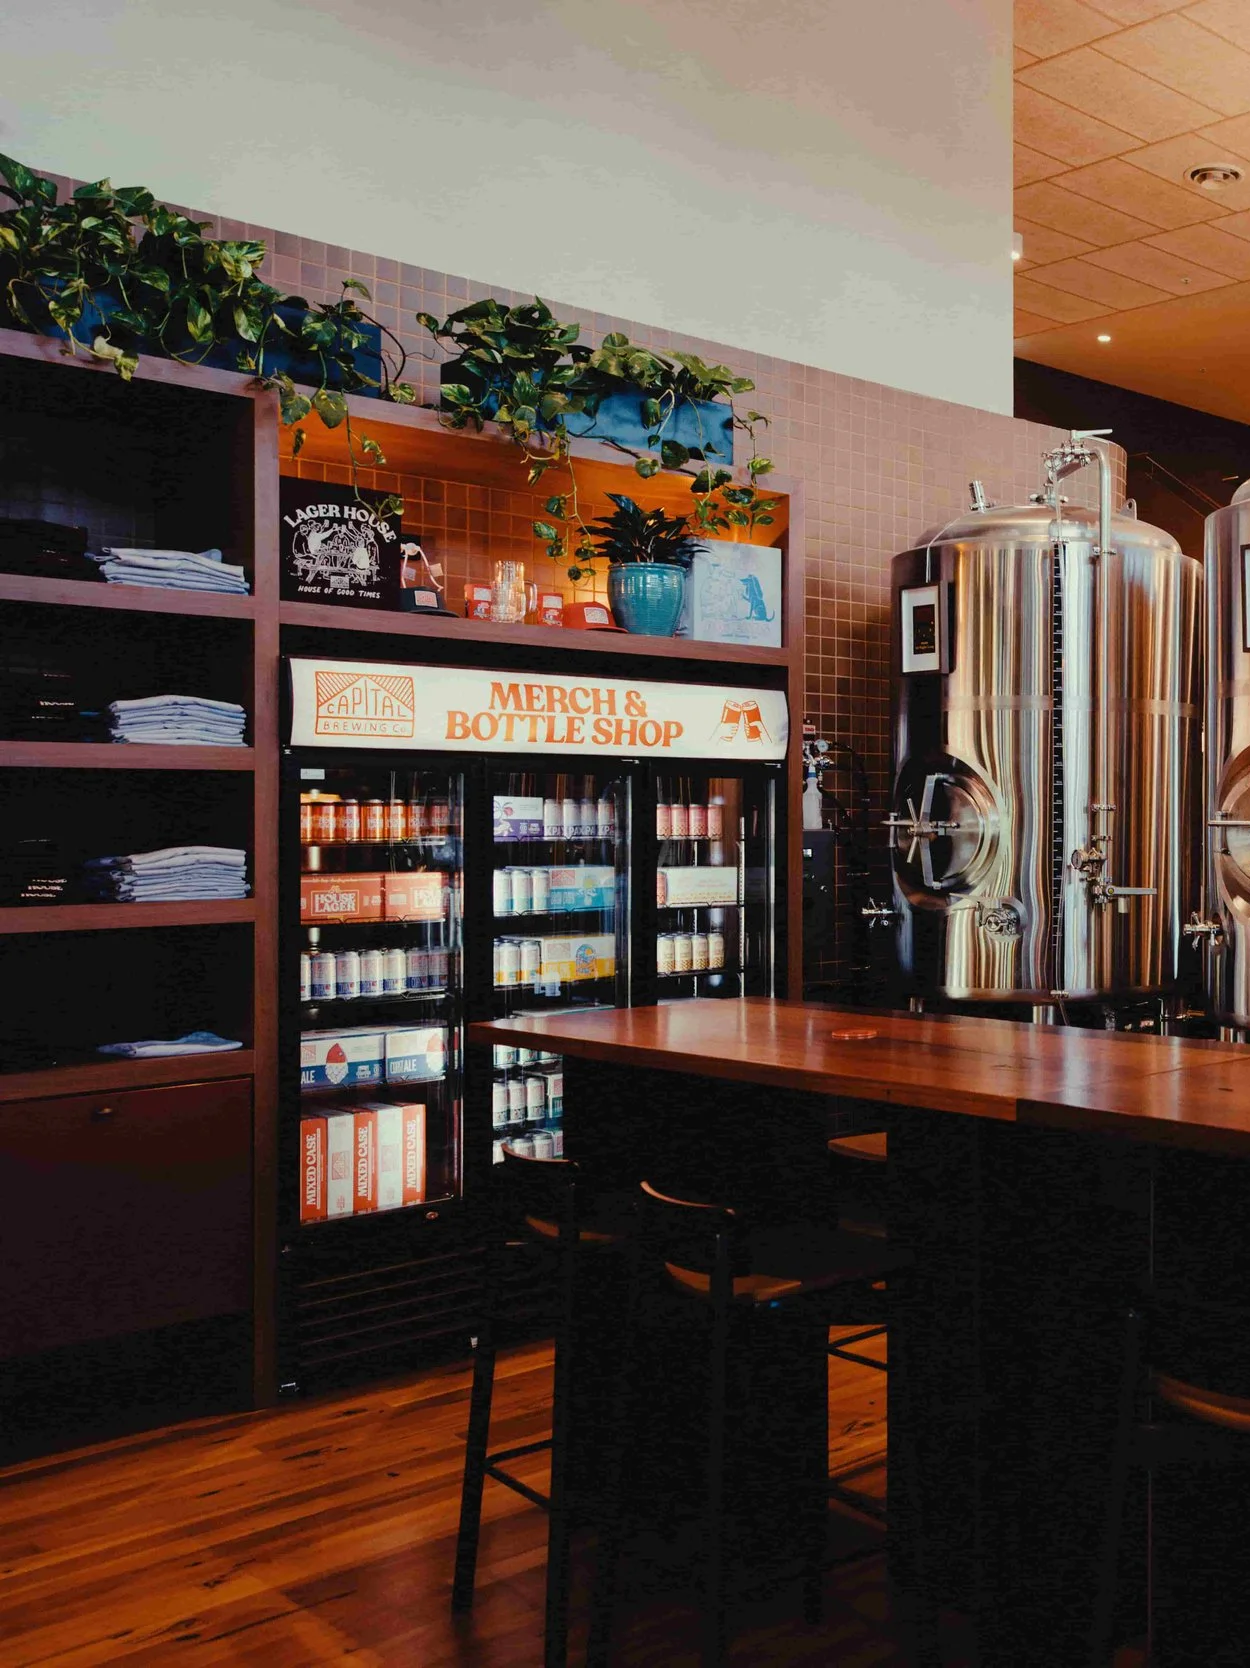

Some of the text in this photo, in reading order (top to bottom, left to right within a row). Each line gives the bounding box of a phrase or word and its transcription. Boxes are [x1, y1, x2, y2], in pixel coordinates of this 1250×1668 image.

[283, 504, 397, 543] LAGER HOUSE
[297, 585, 321, 594] HOUSE
[337, 588, 355, 596] GOOD
[358, 590, 381, 599] TIMES
[326, 679, 407, 718] CAPITAL
[488, 681, 648, 718] MERCH &
[323, 721, 388, 733] BREWING
[445, 710, 684, 747] BOTTLE SHOP
[314, 893, 356, 904] HOUSE
[314, 902, 356, 913] LAGER
[300, 1070, 315, 1084] ALE
[306, 1134, 316, 1205] MIXED CASE
[358, 1127, 368, 1197] MIXED CASE
[407, 1120, 416, 1188] MIXED CASE
